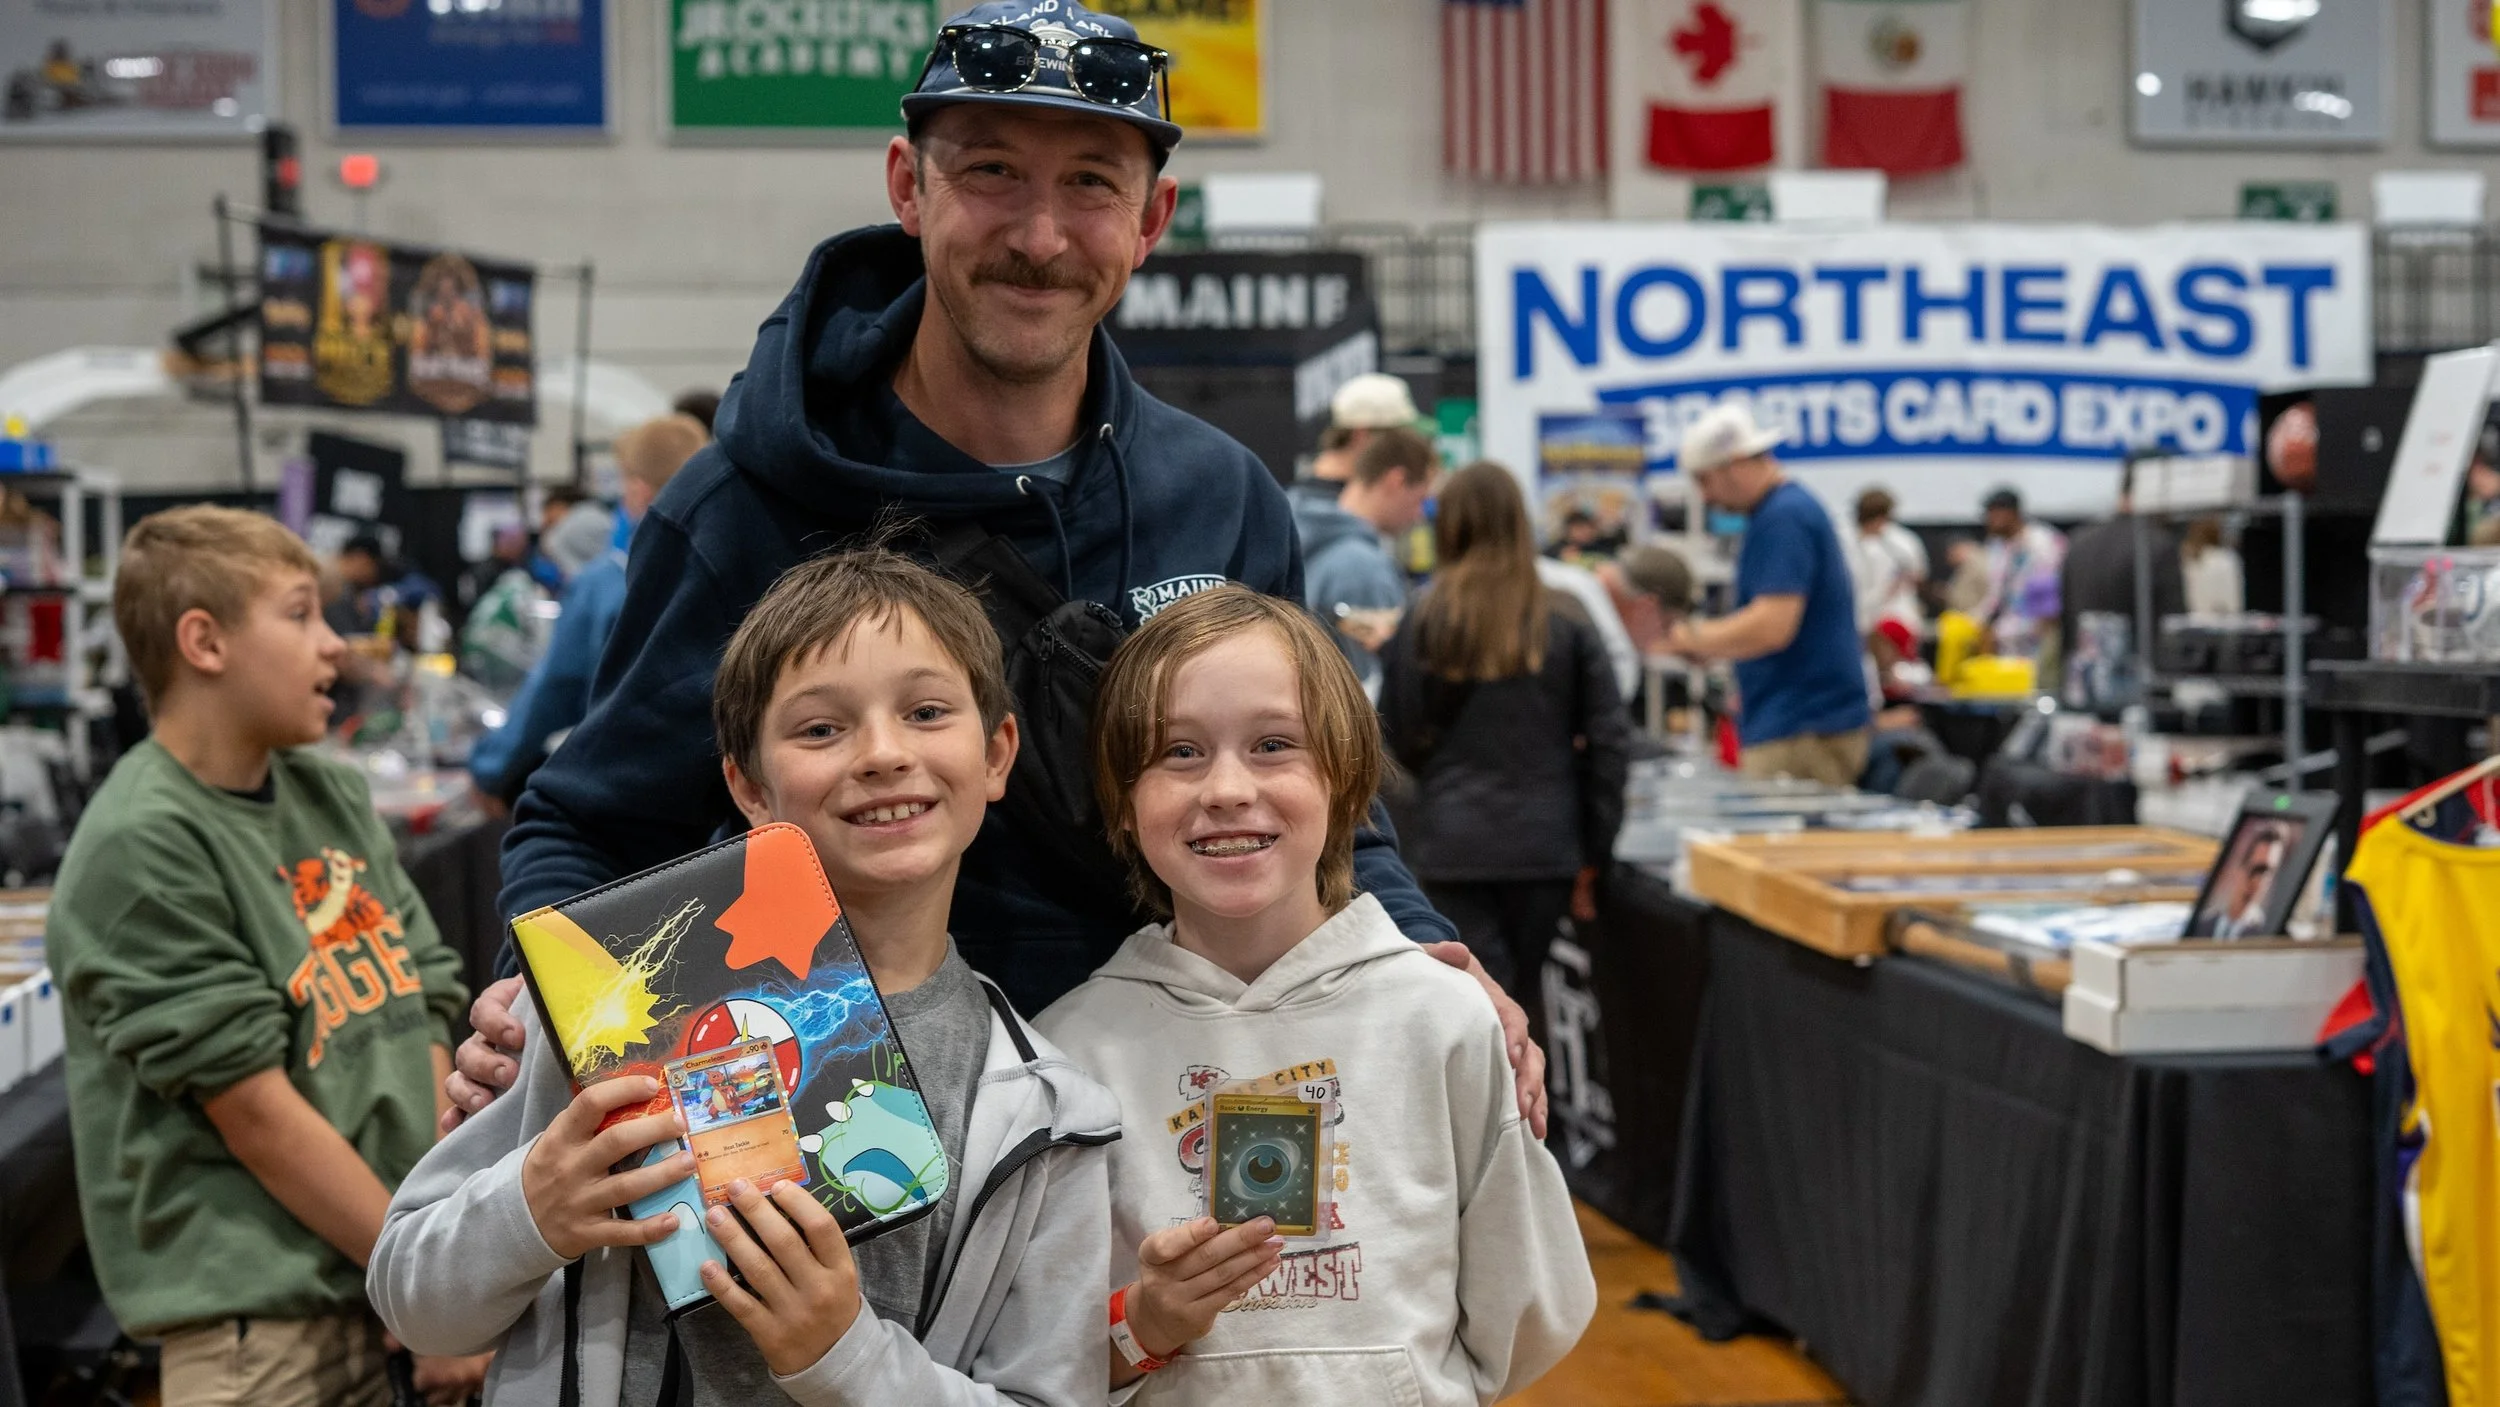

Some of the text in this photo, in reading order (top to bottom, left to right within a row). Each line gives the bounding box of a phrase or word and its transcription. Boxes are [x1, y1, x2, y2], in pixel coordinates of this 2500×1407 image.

[1513, 264, 2336, 381] NORTHEAST
[1884, 377, 2057, 447] CARD
[2059, 383, 2229, 453] EXPO
[750, 1044, 760, 1053] 90
[686, 1054, 725, 1069] Charmeleon
[1275, 1062, 1327, 1086] CITY
[1305, 1085, 1326, 1099] 40
[1245, 1105, 1268, 1113] Energy
